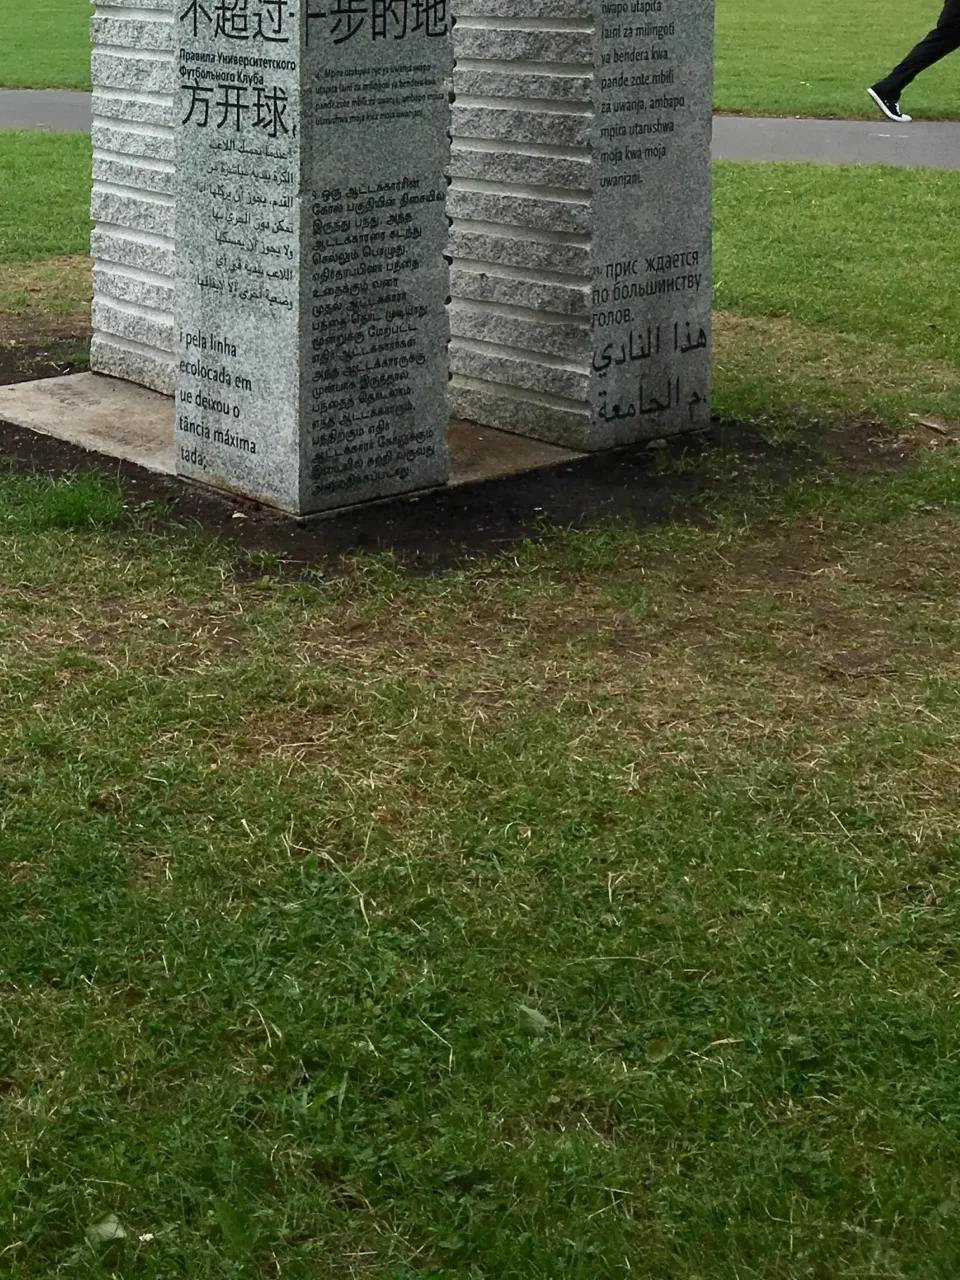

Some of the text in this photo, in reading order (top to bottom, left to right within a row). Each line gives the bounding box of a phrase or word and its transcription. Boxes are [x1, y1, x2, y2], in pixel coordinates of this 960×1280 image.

[592, 273, 702, 304] по большинству
[186, 331, 237, 357] pela linha
[235, 376, 252, 391] em
[233, 405, 240, 418] o
